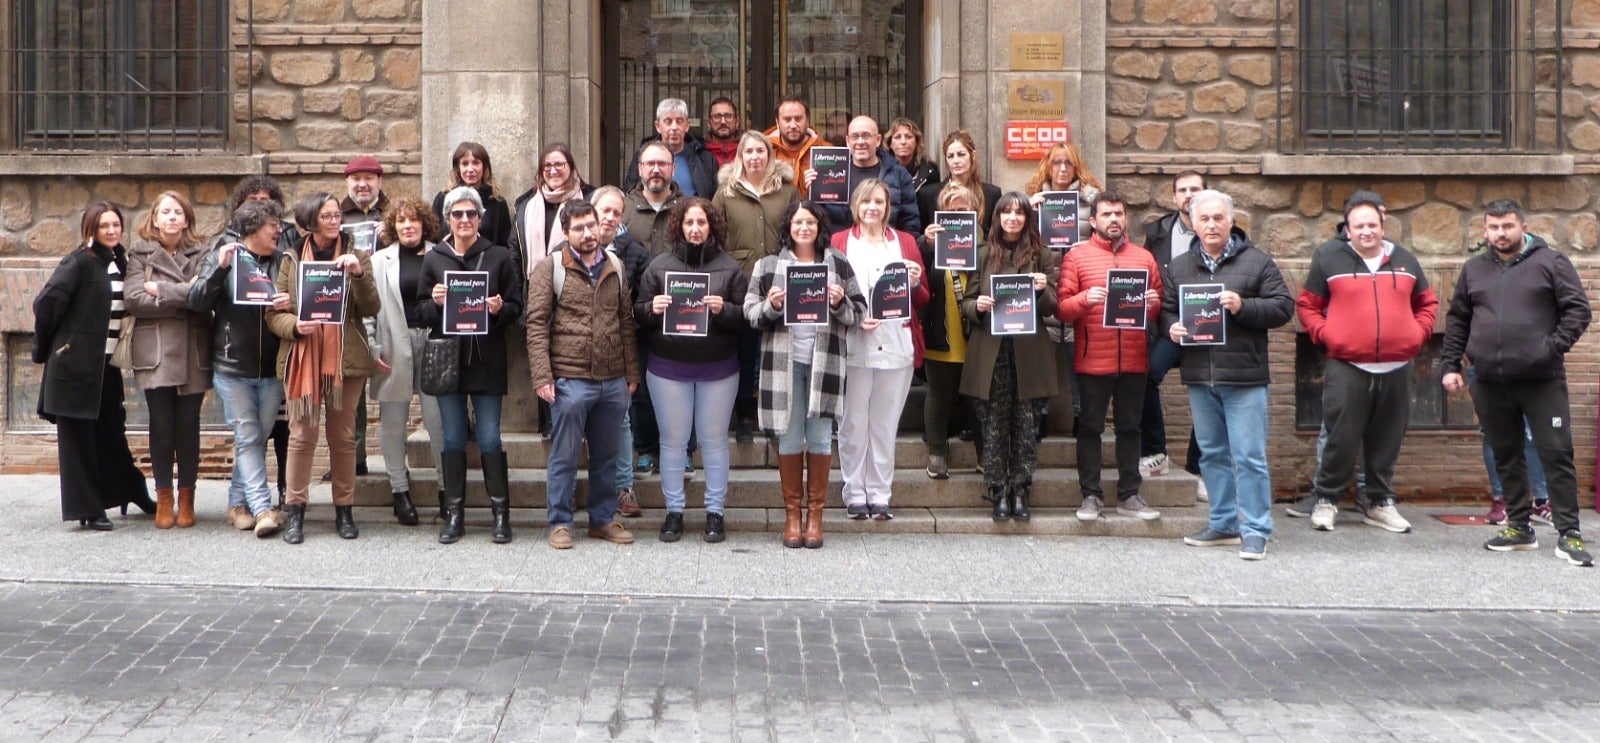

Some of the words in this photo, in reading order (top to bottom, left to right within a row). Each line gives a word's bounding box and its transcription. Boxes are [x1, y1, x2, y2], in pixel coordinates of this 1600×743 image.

[1008, 127, 1067, 141] CCOO
[815, 153, 836, 161] Libertad
[329, 270, 343, 278] para
[790, 271, 813, 279] Libertad
[893, 268, 907, 276] para
[1111, 276, 1133, 284] Libertad
[669, 280, 693, 288] Libertad
[692, 282, 706, 290] para
[995, 281, 1018, 290] Libertad
[1184, 292, 1207, 300] Libertad
